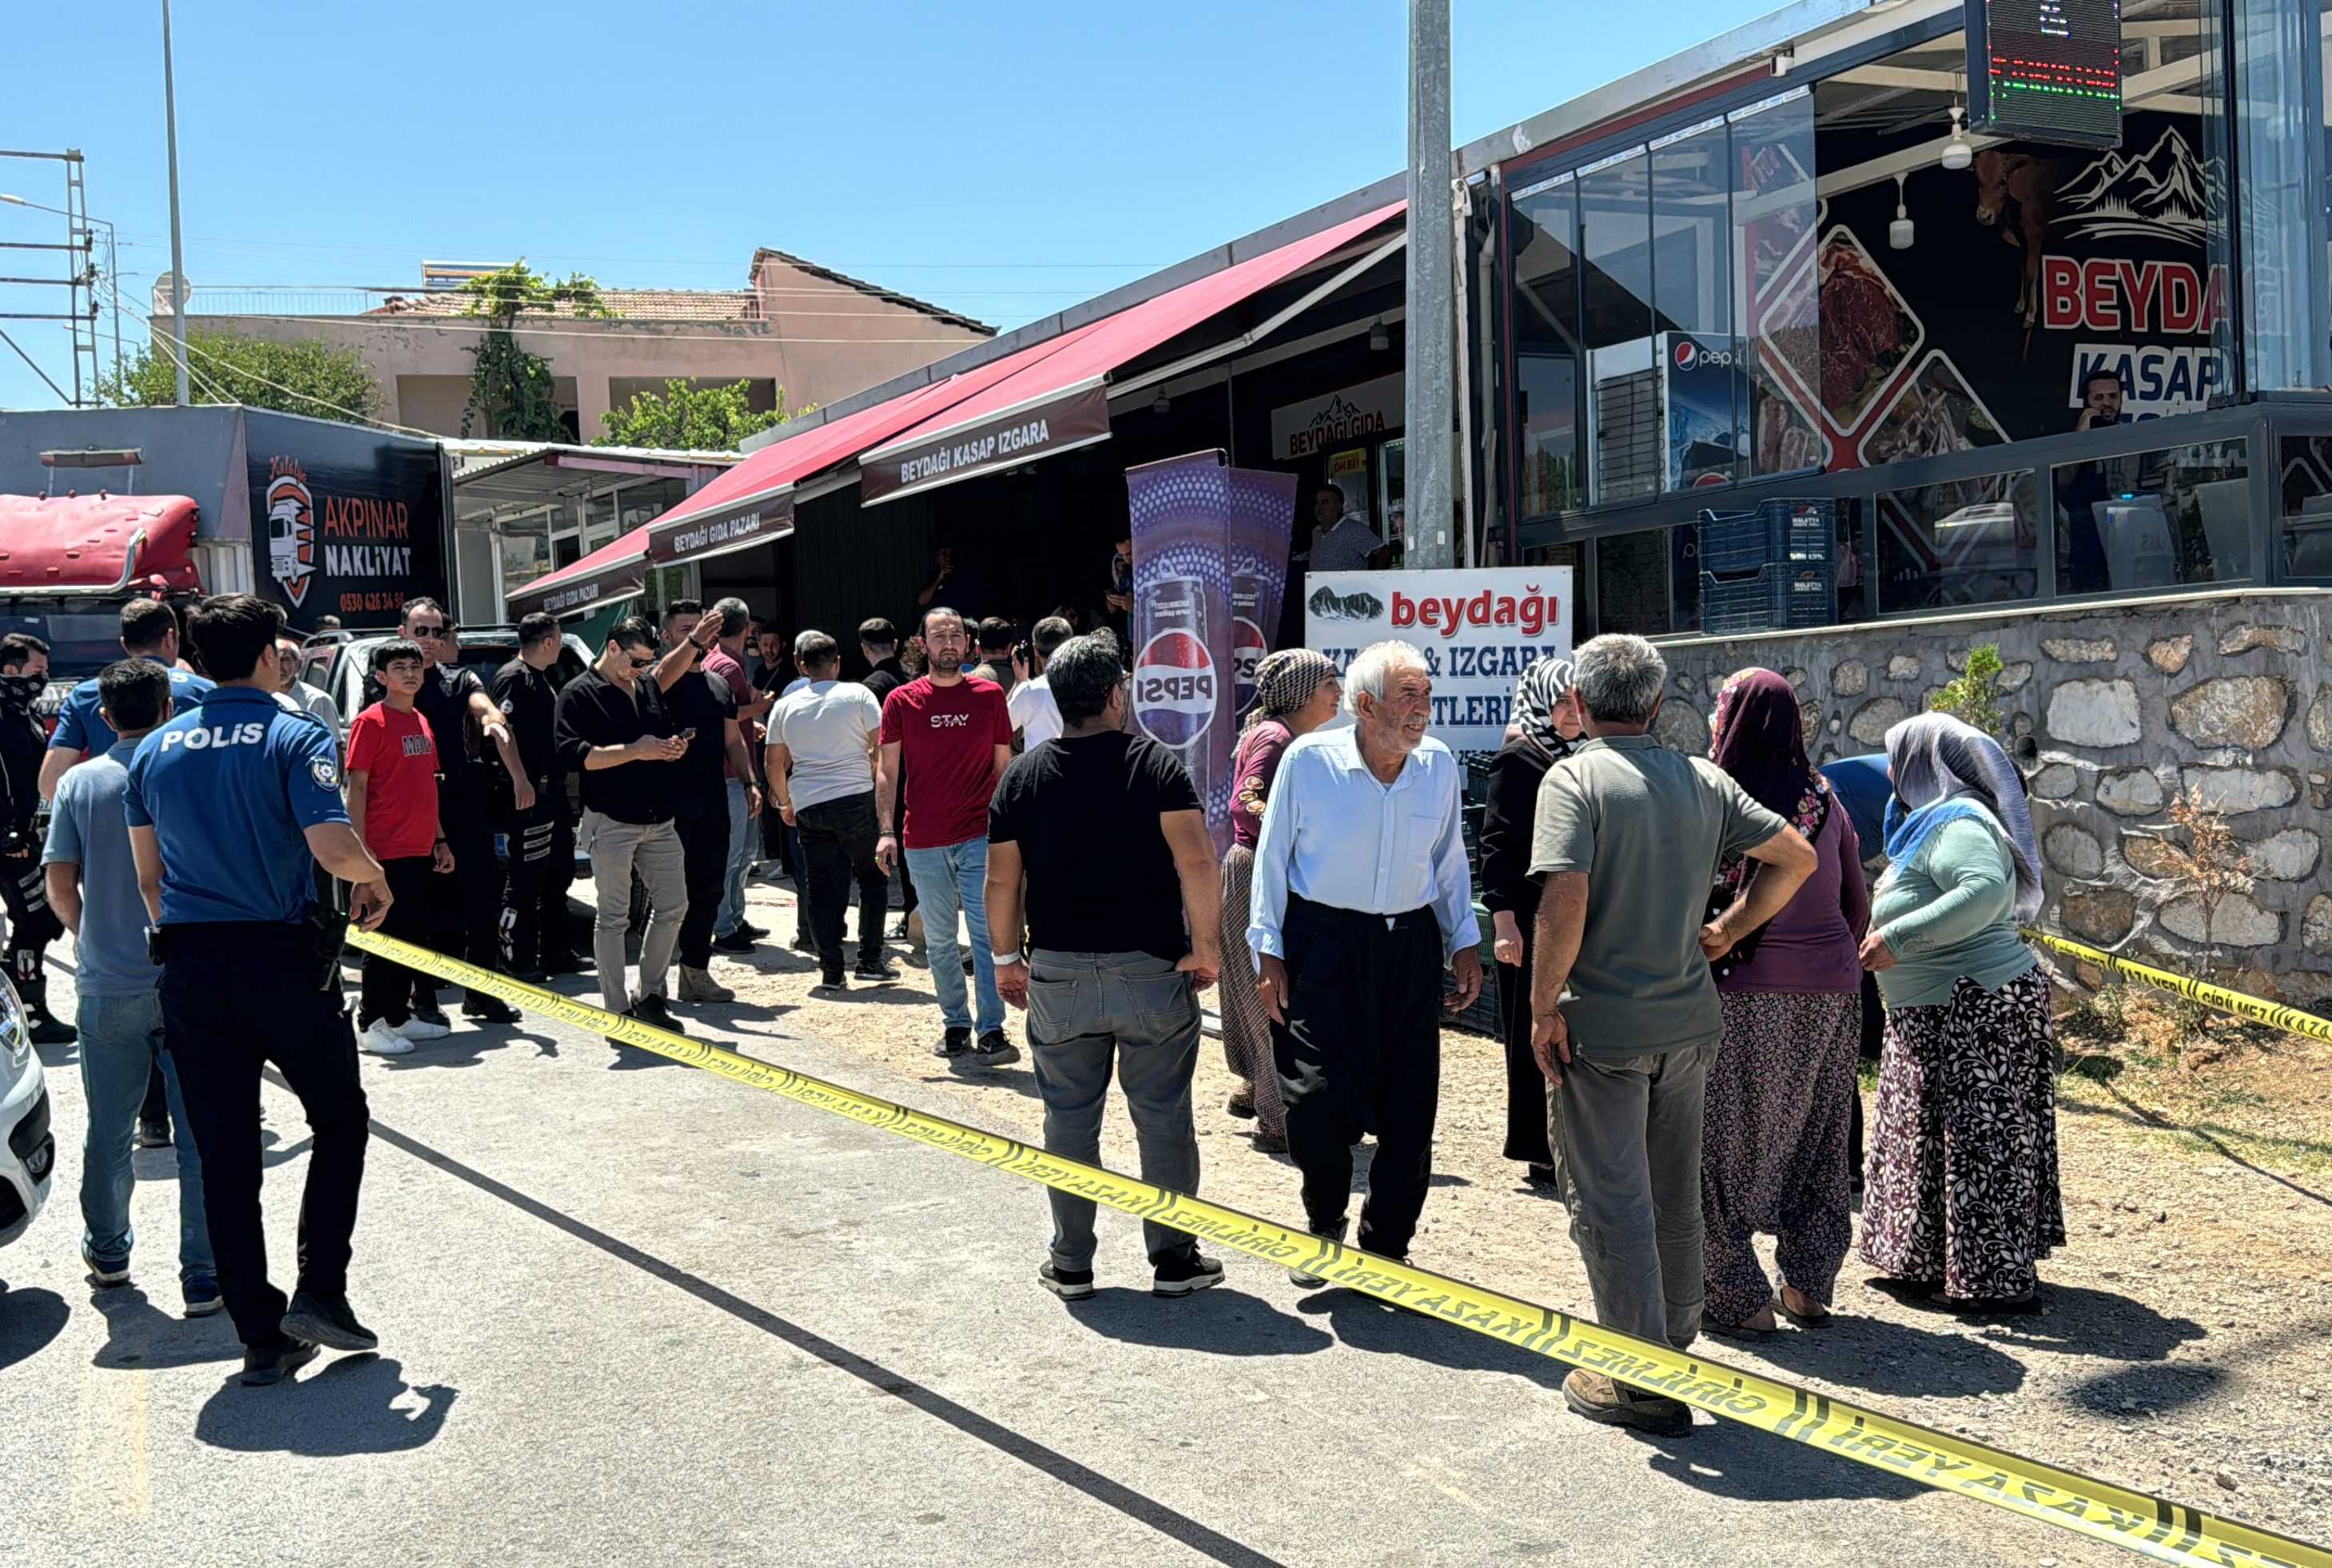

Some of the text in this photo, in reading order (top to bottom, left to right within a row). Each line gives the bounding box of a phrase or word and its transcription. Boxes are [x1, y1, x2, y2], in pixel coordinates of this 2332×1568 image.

[1699, 349, 1741, 368] pepi
[901, 419, 1049, 484] BEYDAĞI KASAP IZGARA
[324, 495, 409, 539] AKPINAR
[674, 511, 760, 553] BEYDAĞI GIDA PAZARI
[1391, 584, 1558, 637] beydağı
[930, 714, 969, 728] STAY
